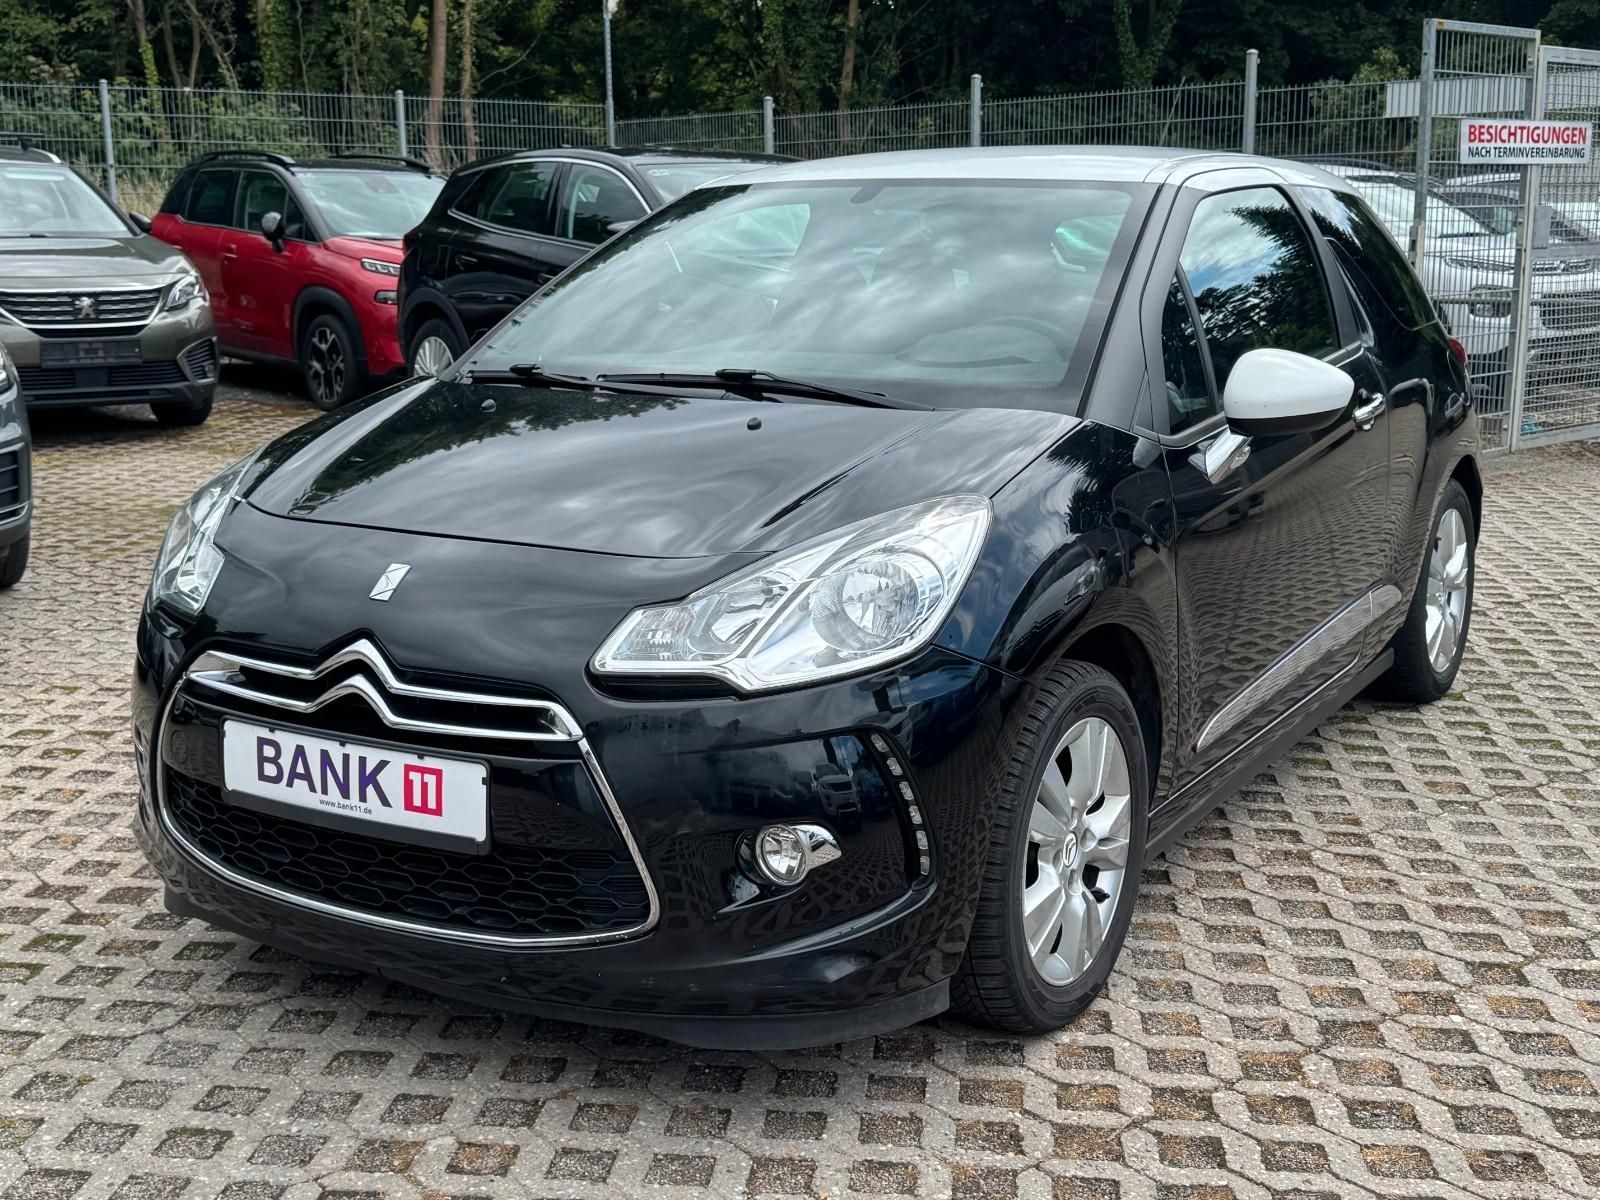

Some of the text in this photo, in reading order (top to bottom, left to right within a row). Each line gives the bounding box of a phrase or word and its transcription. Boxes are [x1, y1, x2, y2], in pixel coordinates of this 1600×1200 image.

[1468, 124, 1587, 144] BESICHTIGUNGEN
[1468, 146, 1585, 158] NACH TERMINVEREINBARUNG
[256, 735, 440, 812] BANK 11
[319, 798, 373, 815] www.bank11.de
